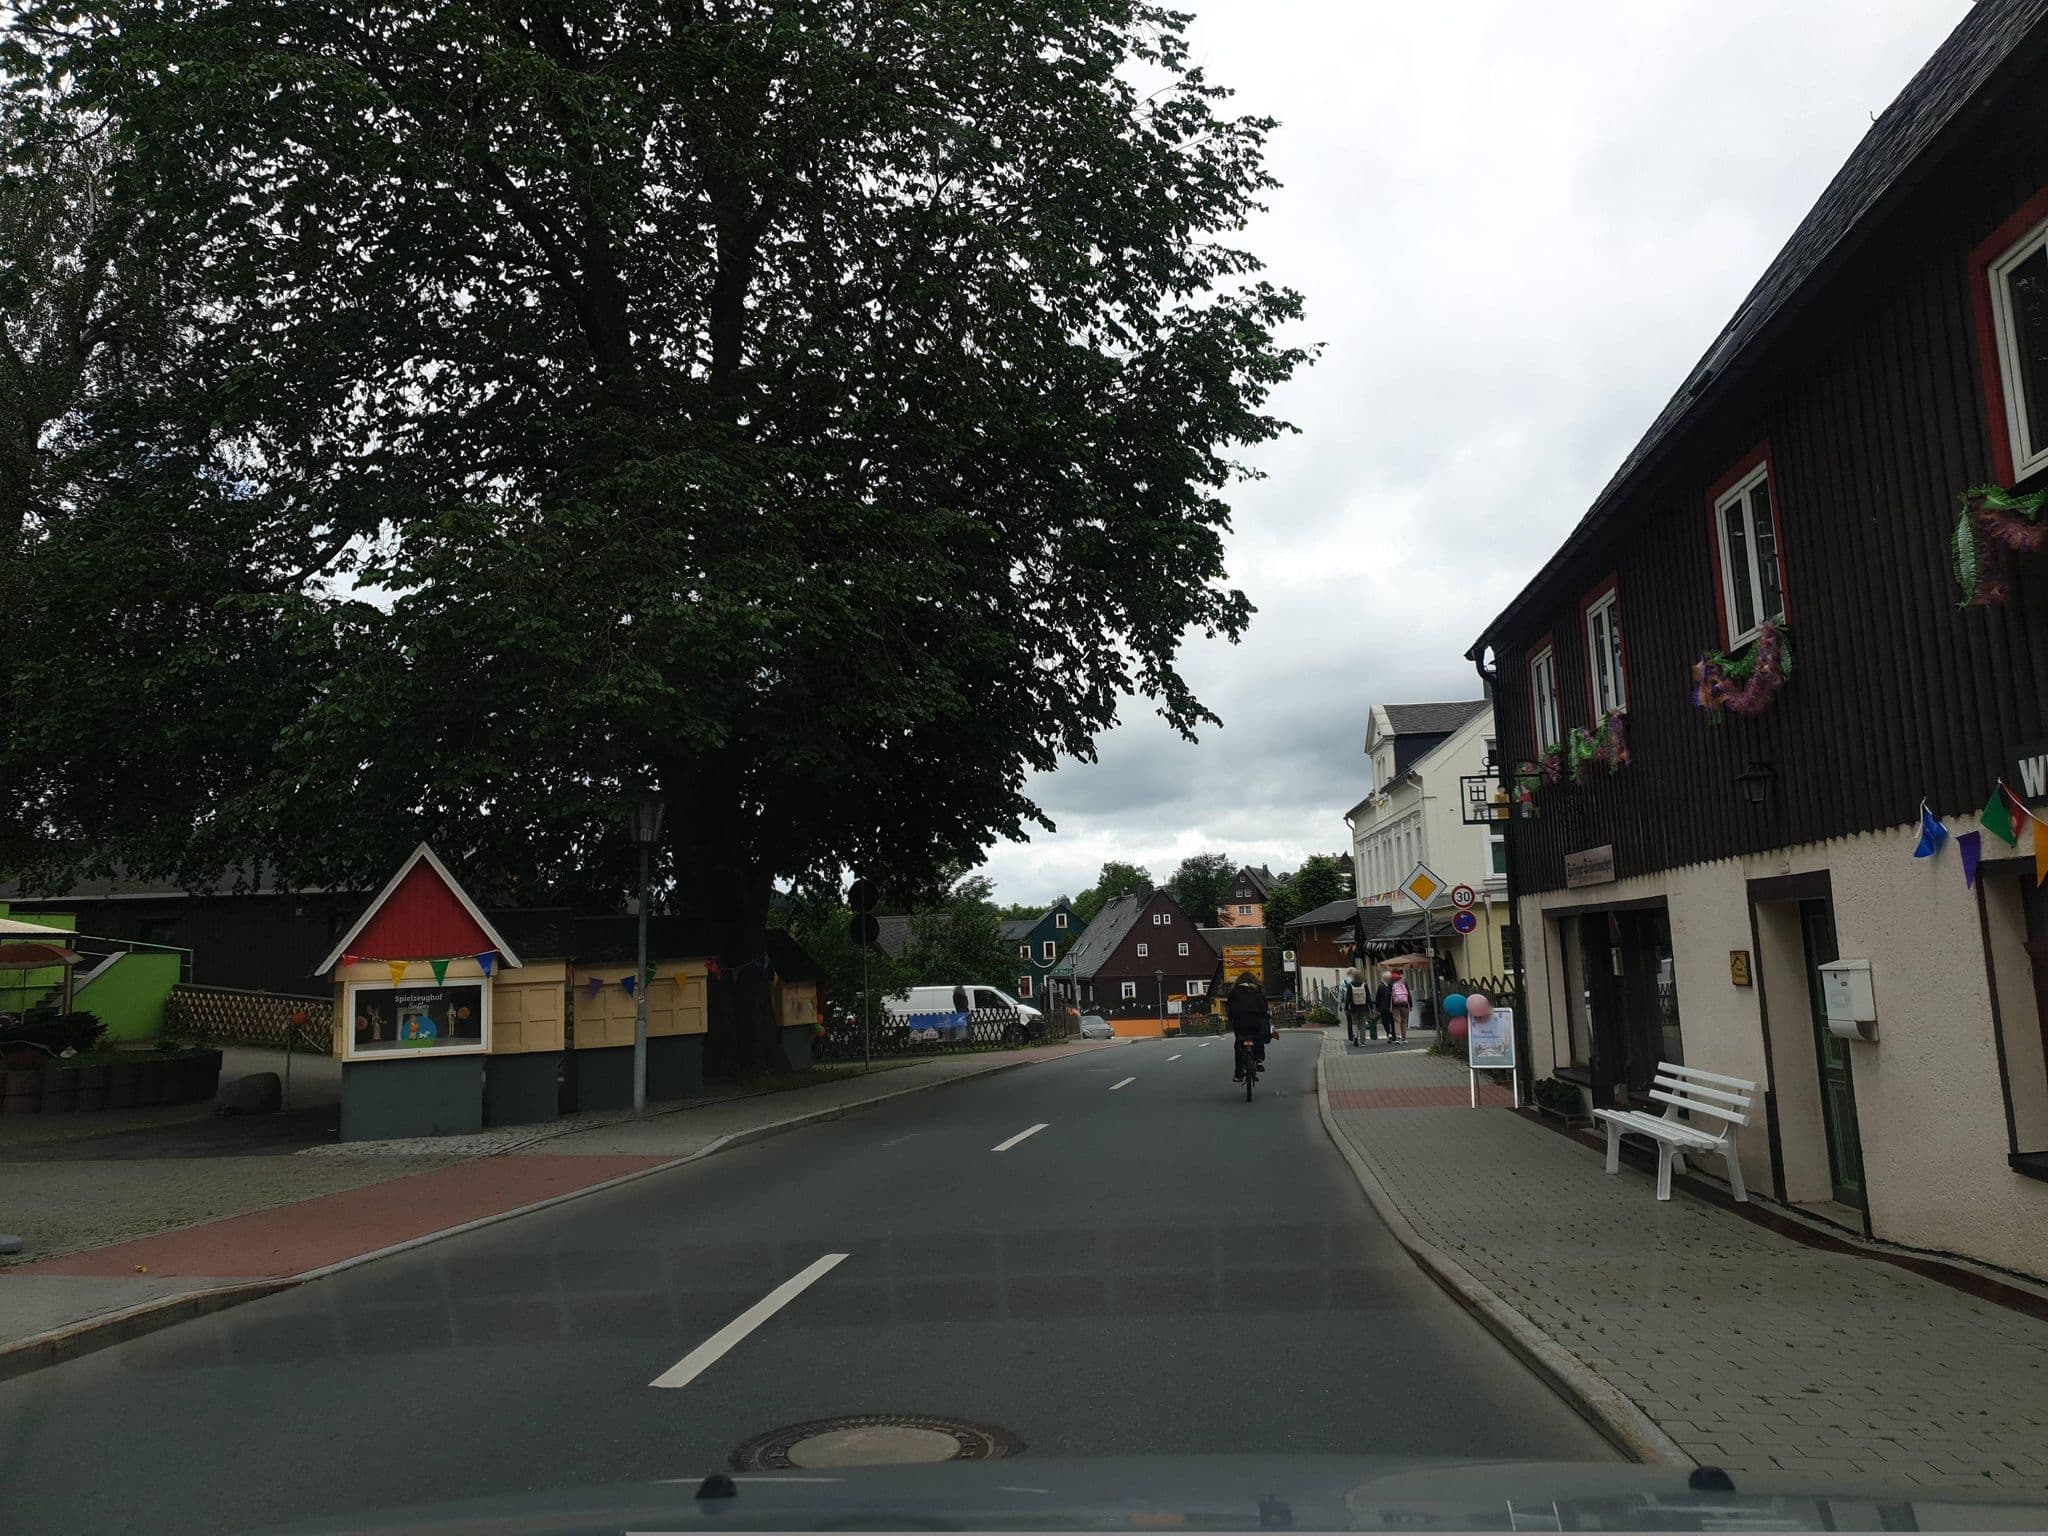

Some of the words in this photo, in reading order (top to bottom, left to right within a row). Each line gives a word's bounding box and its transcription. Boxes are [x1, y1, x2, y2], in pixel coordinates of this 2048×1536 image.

[2018, 754, 2048, 798] W
[1456, 891, 1470, 902] 30
[394, 993, 443, 1004] Spielzeughof
